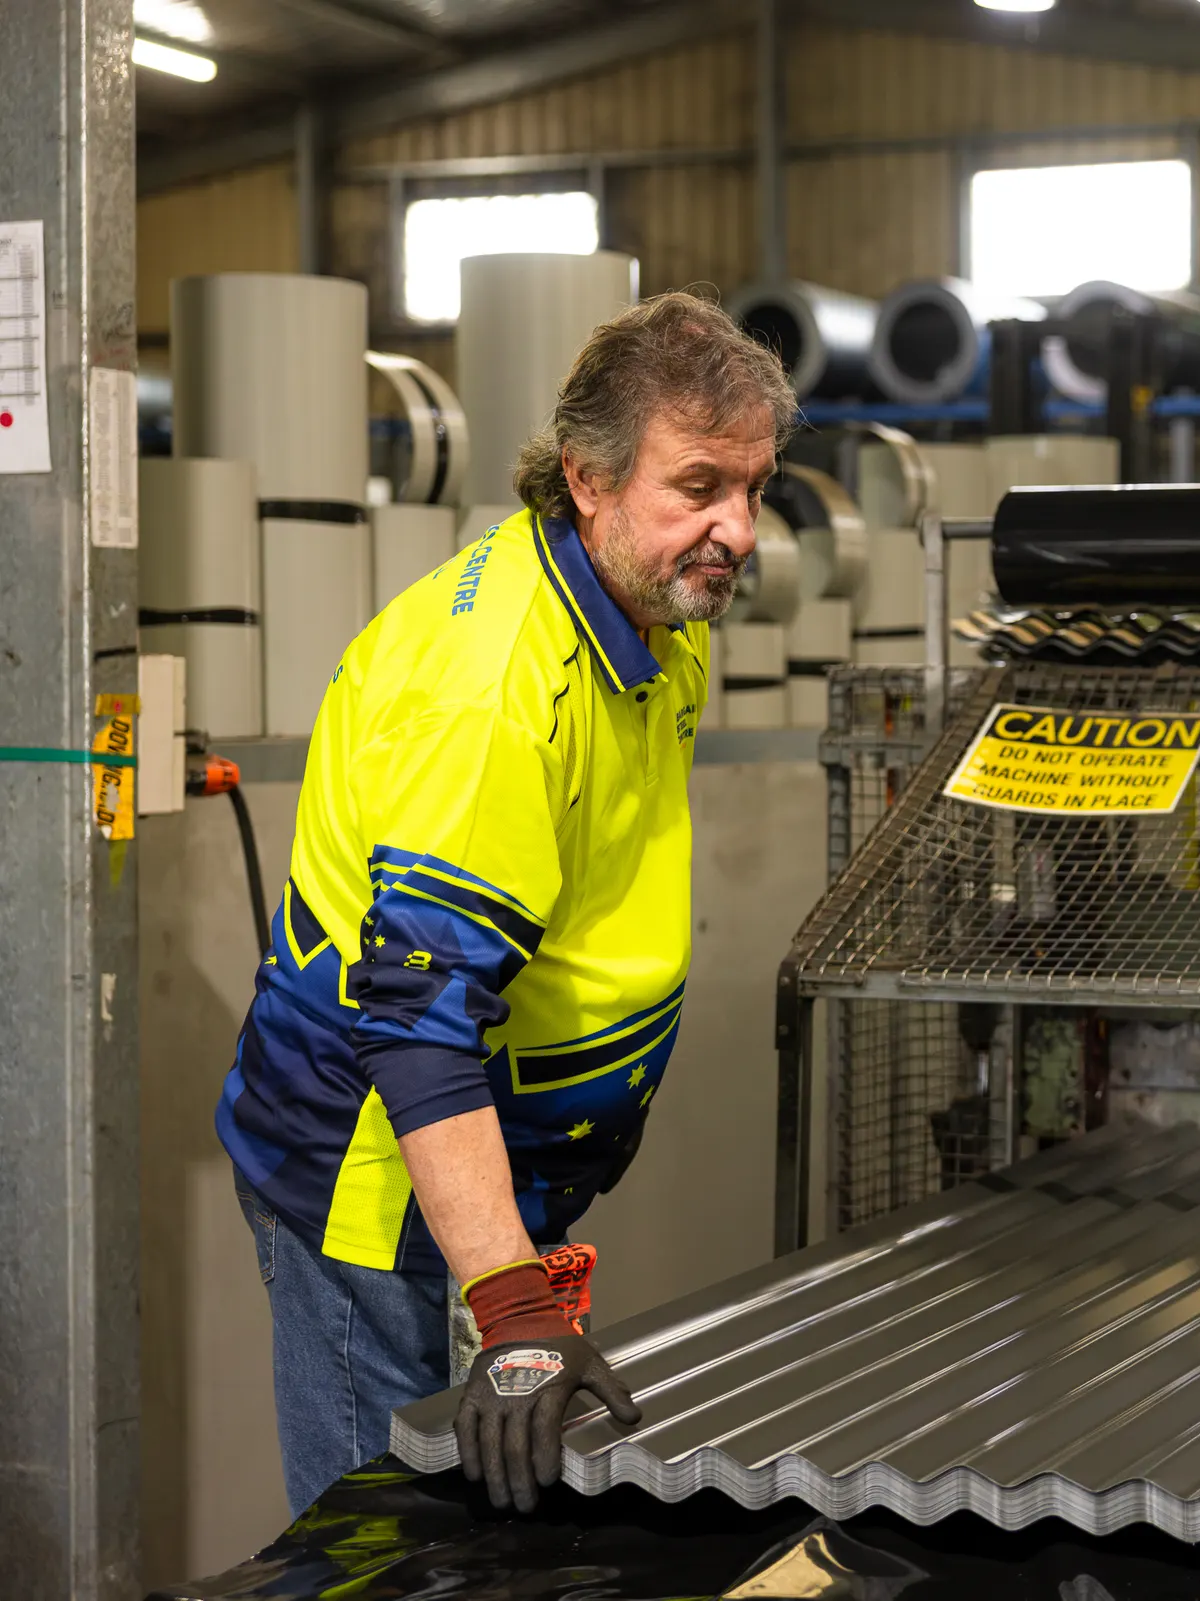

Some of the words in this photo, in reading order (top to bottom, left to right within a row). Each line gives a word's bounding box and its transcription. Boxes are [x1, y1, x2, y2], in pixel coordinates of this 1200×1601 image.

[452, 546, 492, 617] CENTRE
[998, 745, 1027, 761] DO
[1033, 750, 1074, 766] NOT
[1080, 752, 1173, 768] OPERATE
[978, 762, 1073, 787] MACHINE
[1080, 773, 1174, 788] WITHOUT
[1064, 793, 1086, 808] IN
[1090, 793, 1159, 808] PLACE
